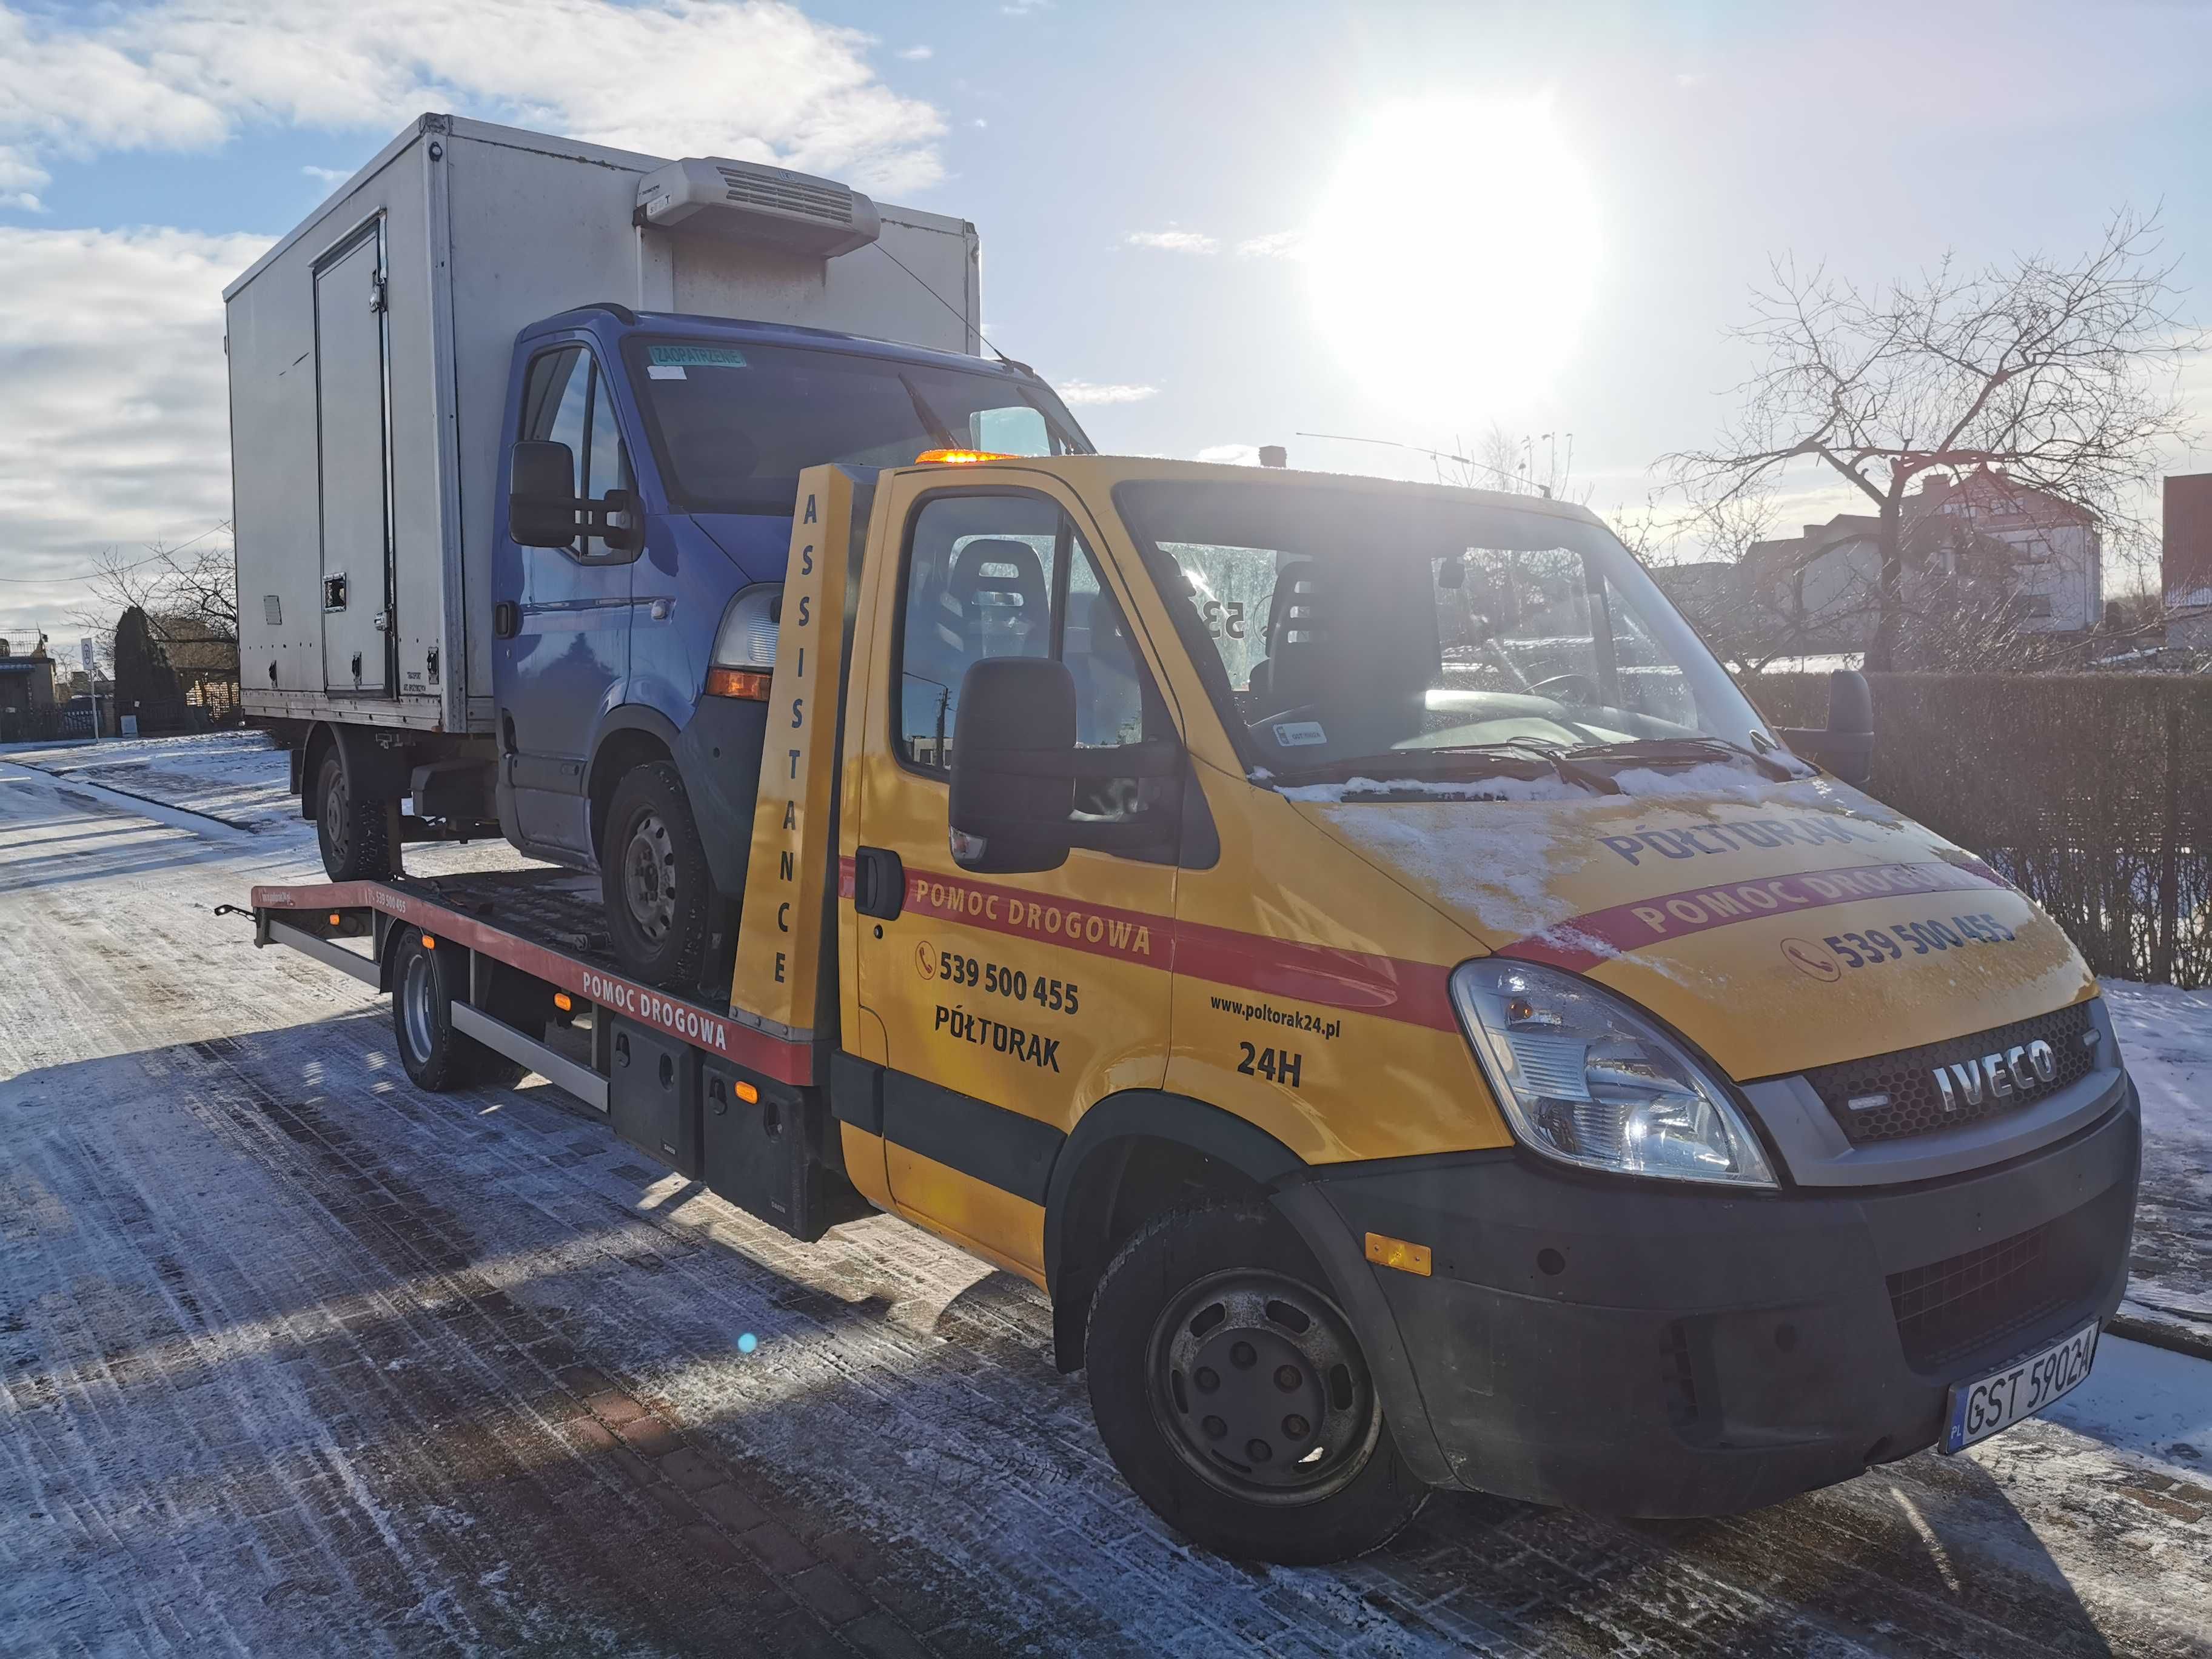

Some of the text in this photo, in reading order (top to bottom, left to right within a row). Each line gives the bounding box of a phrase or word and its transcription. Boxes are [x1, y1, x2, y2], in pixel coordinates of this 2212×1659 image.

[654, 347, 742, 364] ZAOPATRZENIE
[773, 493, 818, 984] ASSISTANCE
[1597, 816, 1877, 866] PÓŁTORAK
[916, 879, 1150, 956] POMOC DROGOWA
[1629, 863, 1978, 934] POMOC DROGO
[1822, 914, 2016, 968] 539 500 455
[583, 971, 726, 1051] POMOC DROGOWA
[940, 951, 1079, 1015] 539 500 455
[935, 1004, 1060, 1074] PÓŁTORAK
[1210, 996, 1341, 1041] www.poltorak24.pl
[1237, 1041, 1302, 1088] 24H
[1931, 1039, 2057, 1112] IVECO
[1966, 1329, 2092, 1435] GST 5902A
[1950, 1424, 1962, 1439] PL
